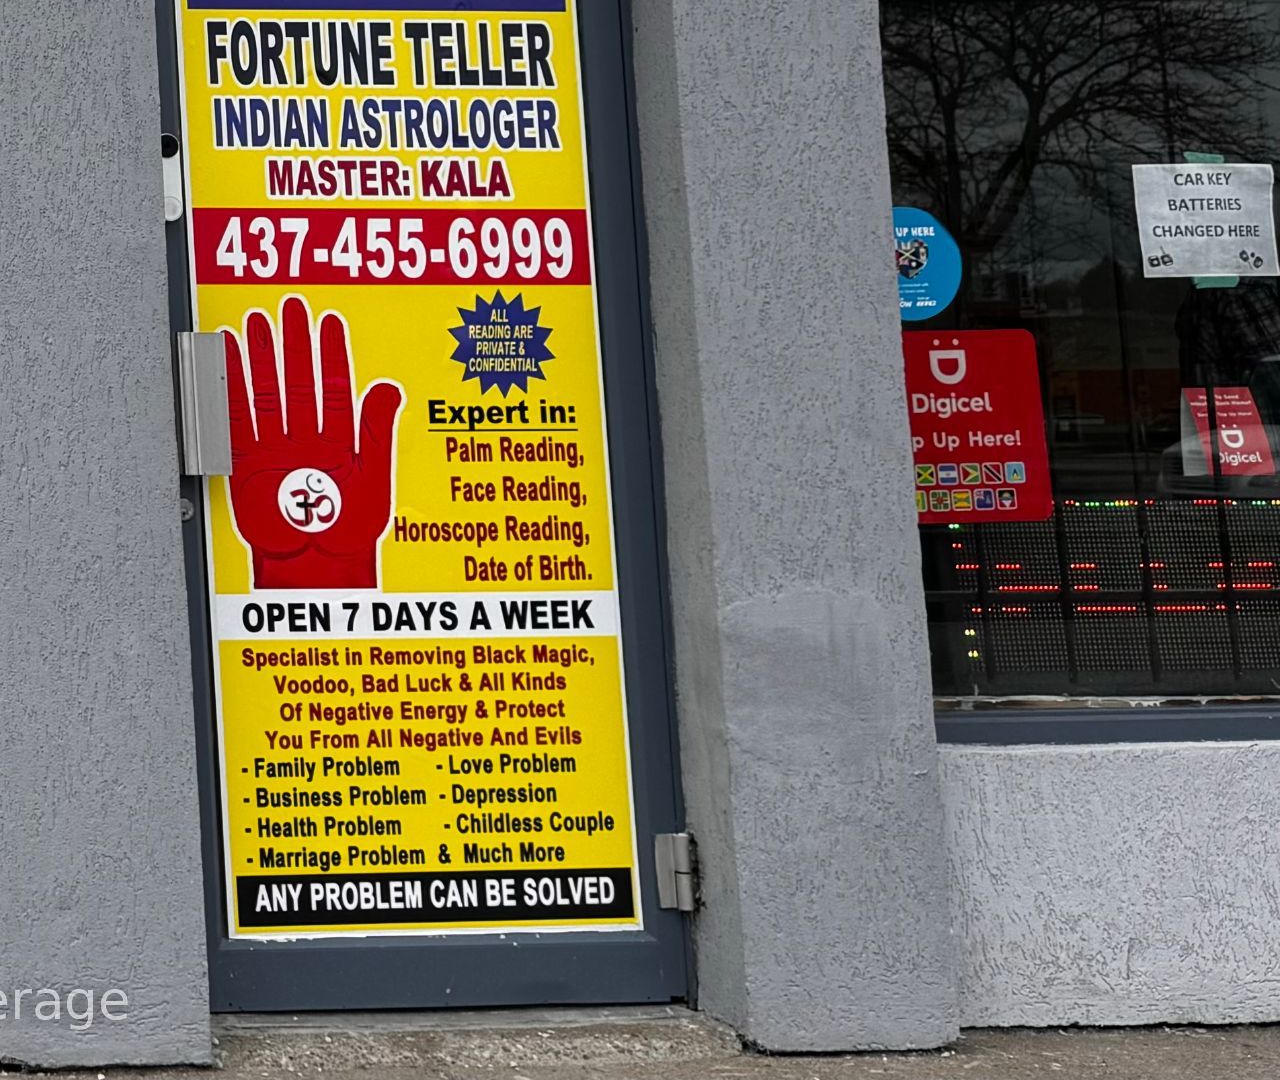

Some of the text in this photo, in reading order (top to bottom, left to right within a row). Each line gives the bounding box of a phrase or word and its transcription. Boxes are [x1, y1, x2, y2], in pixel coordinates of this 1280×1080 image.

[206, 20, 555, 88] FORTUNE TELLER
[212, 97, 561, 150] INDIAN ASTROLOGER
[267, 158, 511, 198] MASTER: KALA
[1173, 172, 1232, 186] CAR KEY
[1167, 198, 1242, 212] BATTERIES
[895, 226, 936, 237] UP HERE
[1152, 224, 1261, 238] CHANGED HERE
[215, 216, 573, 279] 437-455-6999
[490, 308, 509, 323] ALL
[468, 324, 534, 339] READING ARE
[475, 340, 526, 356] PRIVATE &
[468, 357, 538, 372] CONFIDENTIAL
[427, 398, 577, 431] Expert in:
[911, 391, 994, 419] Digicel
[445, 436, 585, 469] Palm Reading,
[932, 431, 960, 452] Up
[968, 429, 1022, 448] Here!
[450, 475, 588, 508] Face Reading,
[393, 514, 591, 548] Horoscope Reading,
[463, 554, 593, 582] Date of Birth.
[241, 599, 595, 633] OPEN 7 DAYS A WEEK
[241, 644, 595, 672] Specialist in Removing Black Magic,
[273, 671, 567, 698] Voodoo, Bad Luck & All Kinds
[279, 698, 566, 726] Of Negative Energy & Protect
[264, 725, 583, 752] You From All Negative And Evils
[254, 755, 401, 783] Family Problem
[448, 752, 577, 776] Love Problem
[255, 785, 427, 809] Business Problem
[451, 782, 558, 809] Depression
[256, 815, 402, 839] Health Problem
[456, 810, 615, 837] Childless Couple
[259, 842, 566, 873] Marriage Problem & Much More
[255, 875, 616, 914] ANY PROBLEM CAN BE SOLVED
